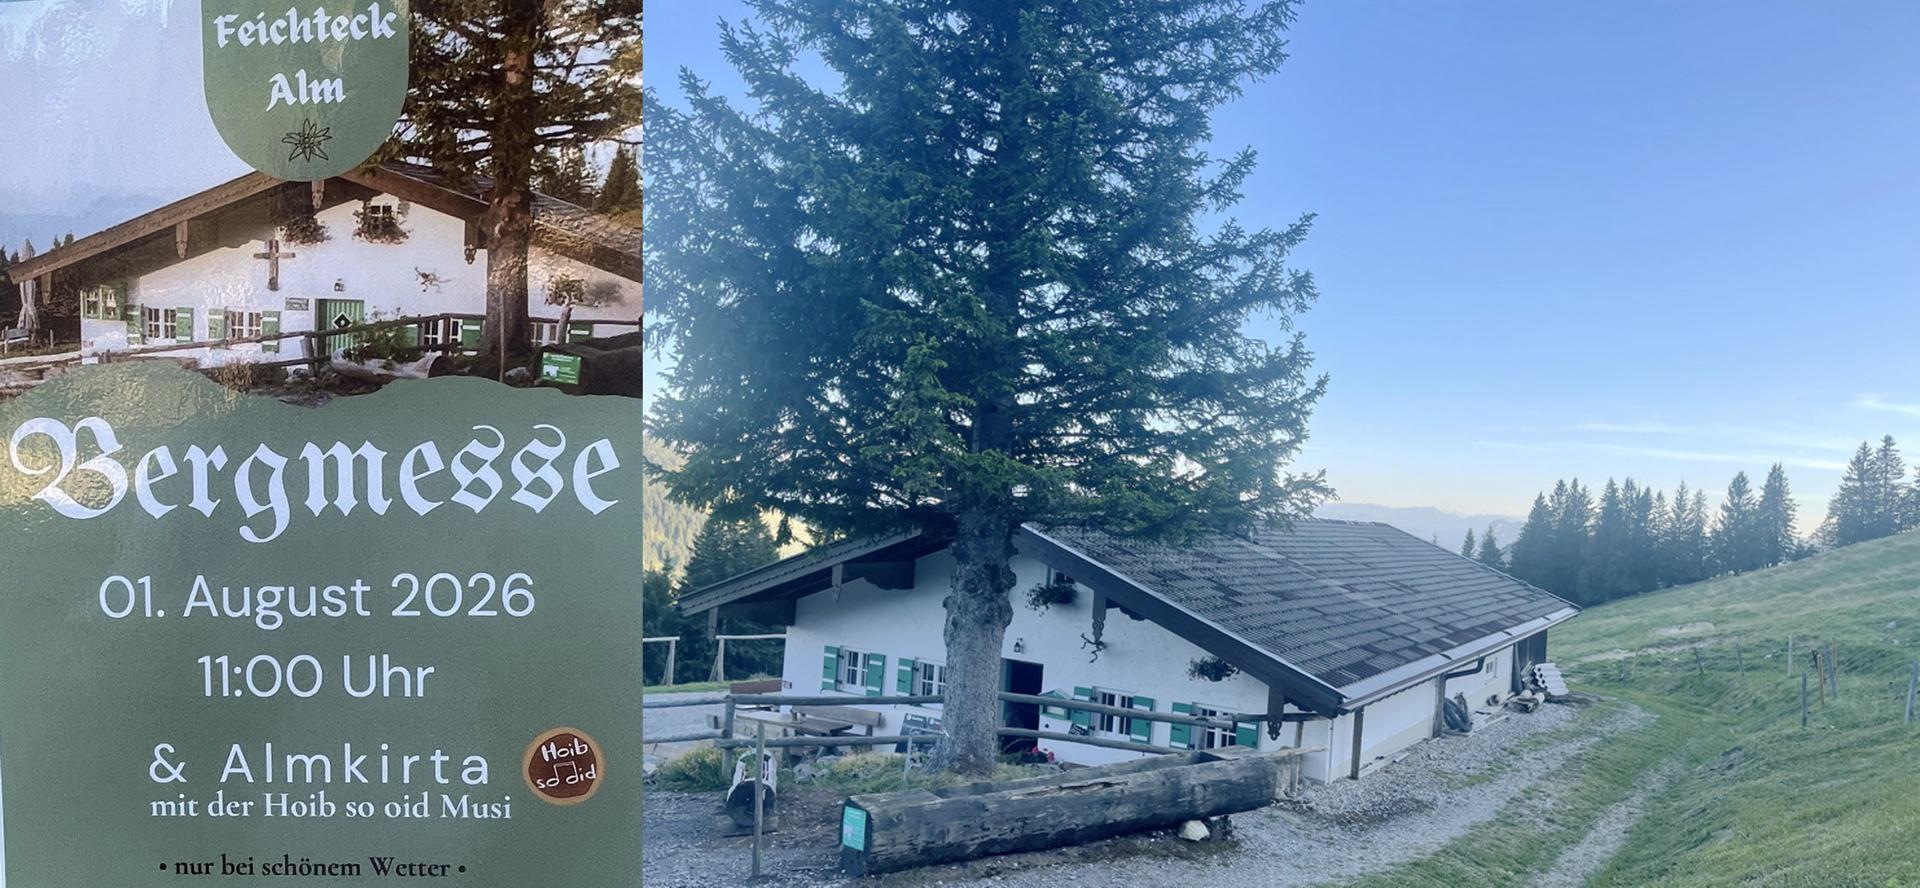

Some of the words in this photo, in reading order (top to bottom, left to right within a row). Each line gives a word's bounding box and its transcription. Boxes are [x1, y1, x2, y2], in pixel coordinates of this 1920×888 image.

[213, 1, 398, 49] Feichteck
[265, 68, 347, 112] Alm
[9, 416, 621, 543] Bergmesse
[99, 575, 165, 619] 01.
[183, 574, 371, 631] August
[391, 572, 536, 618] 2026
[197, 654, 324, 698] 11:00
[343, 653, 436, 698] Uhr
[149, 743, 187, 783] &
[219, 742, 490, 785] Almkirta
[541, 738, 588, 762] Hoib
[150, 793, 199, 818] mit
[207, 789, 254, 818] der
[264, 790, 336, 819] Hoib
[345, 801, 375, 819] so
[384, 790, 431, 819] oid
[440, 793, 512, 820] Musi
[174, 862, 215, 876] nur
[220, 853, 254, 877] bei
[262, 854, 362, 878] schönem
[369, 856, 451, 878] Wetter
